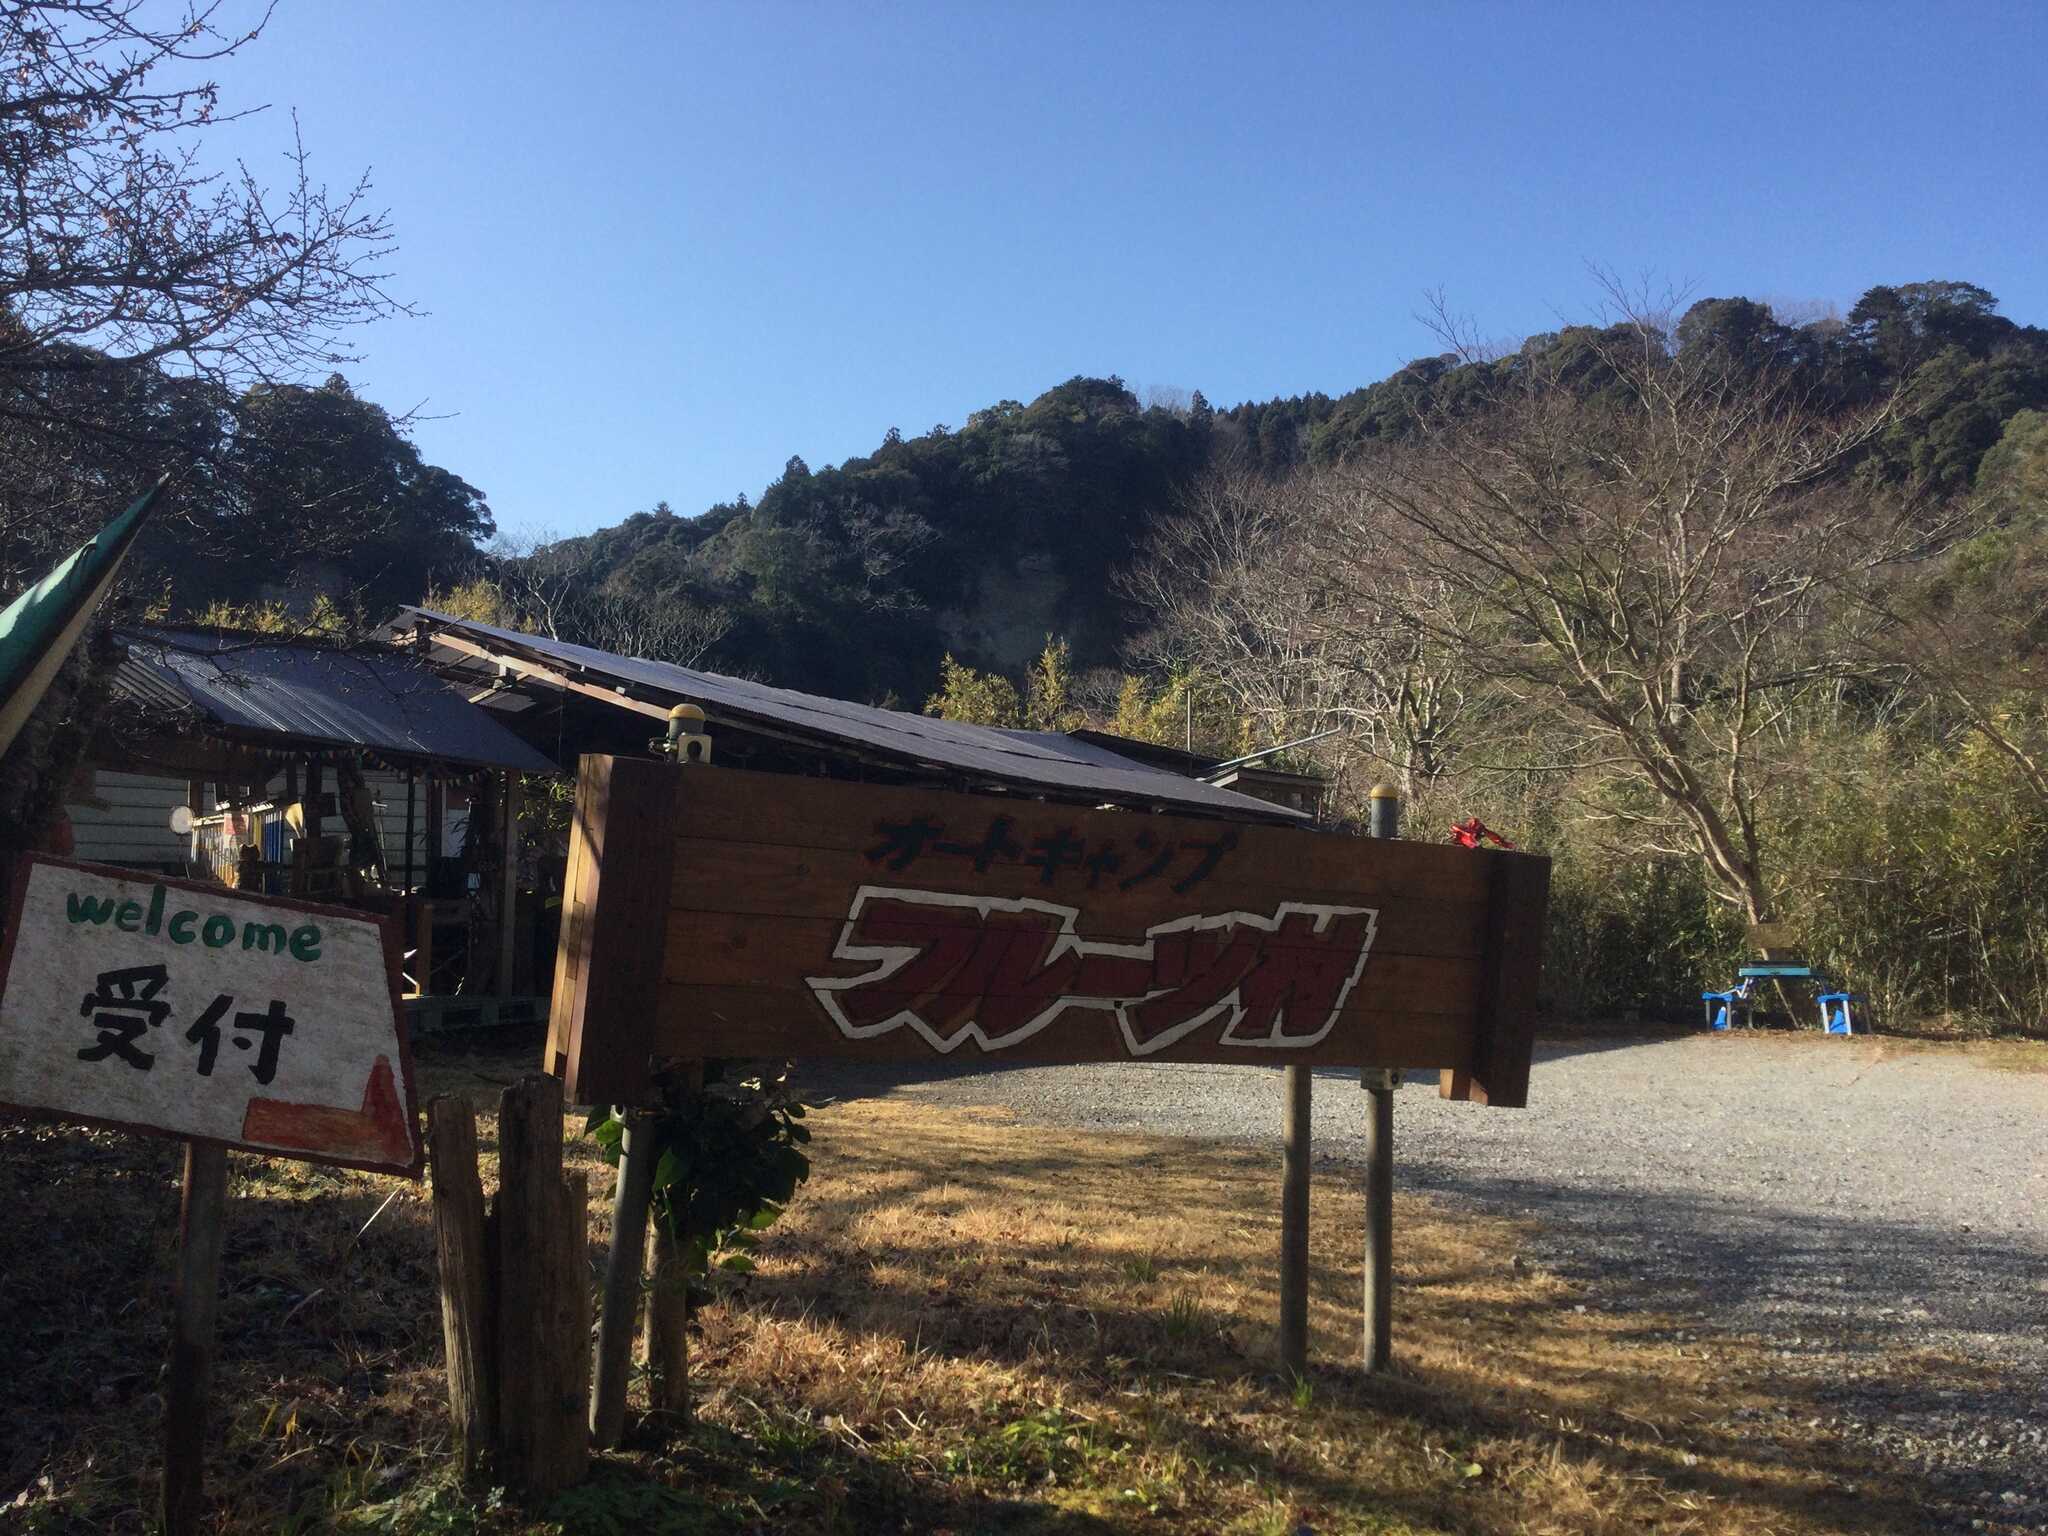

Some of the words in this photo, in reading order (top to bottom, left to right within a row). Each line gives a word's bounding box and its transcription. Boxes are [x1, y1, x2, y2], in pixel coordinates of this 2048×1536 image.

[865, 816, 1239, 894] オートキャンプ
[66, 884, 322, 962] welcome
[77, 964, 295, 1085] 受付
